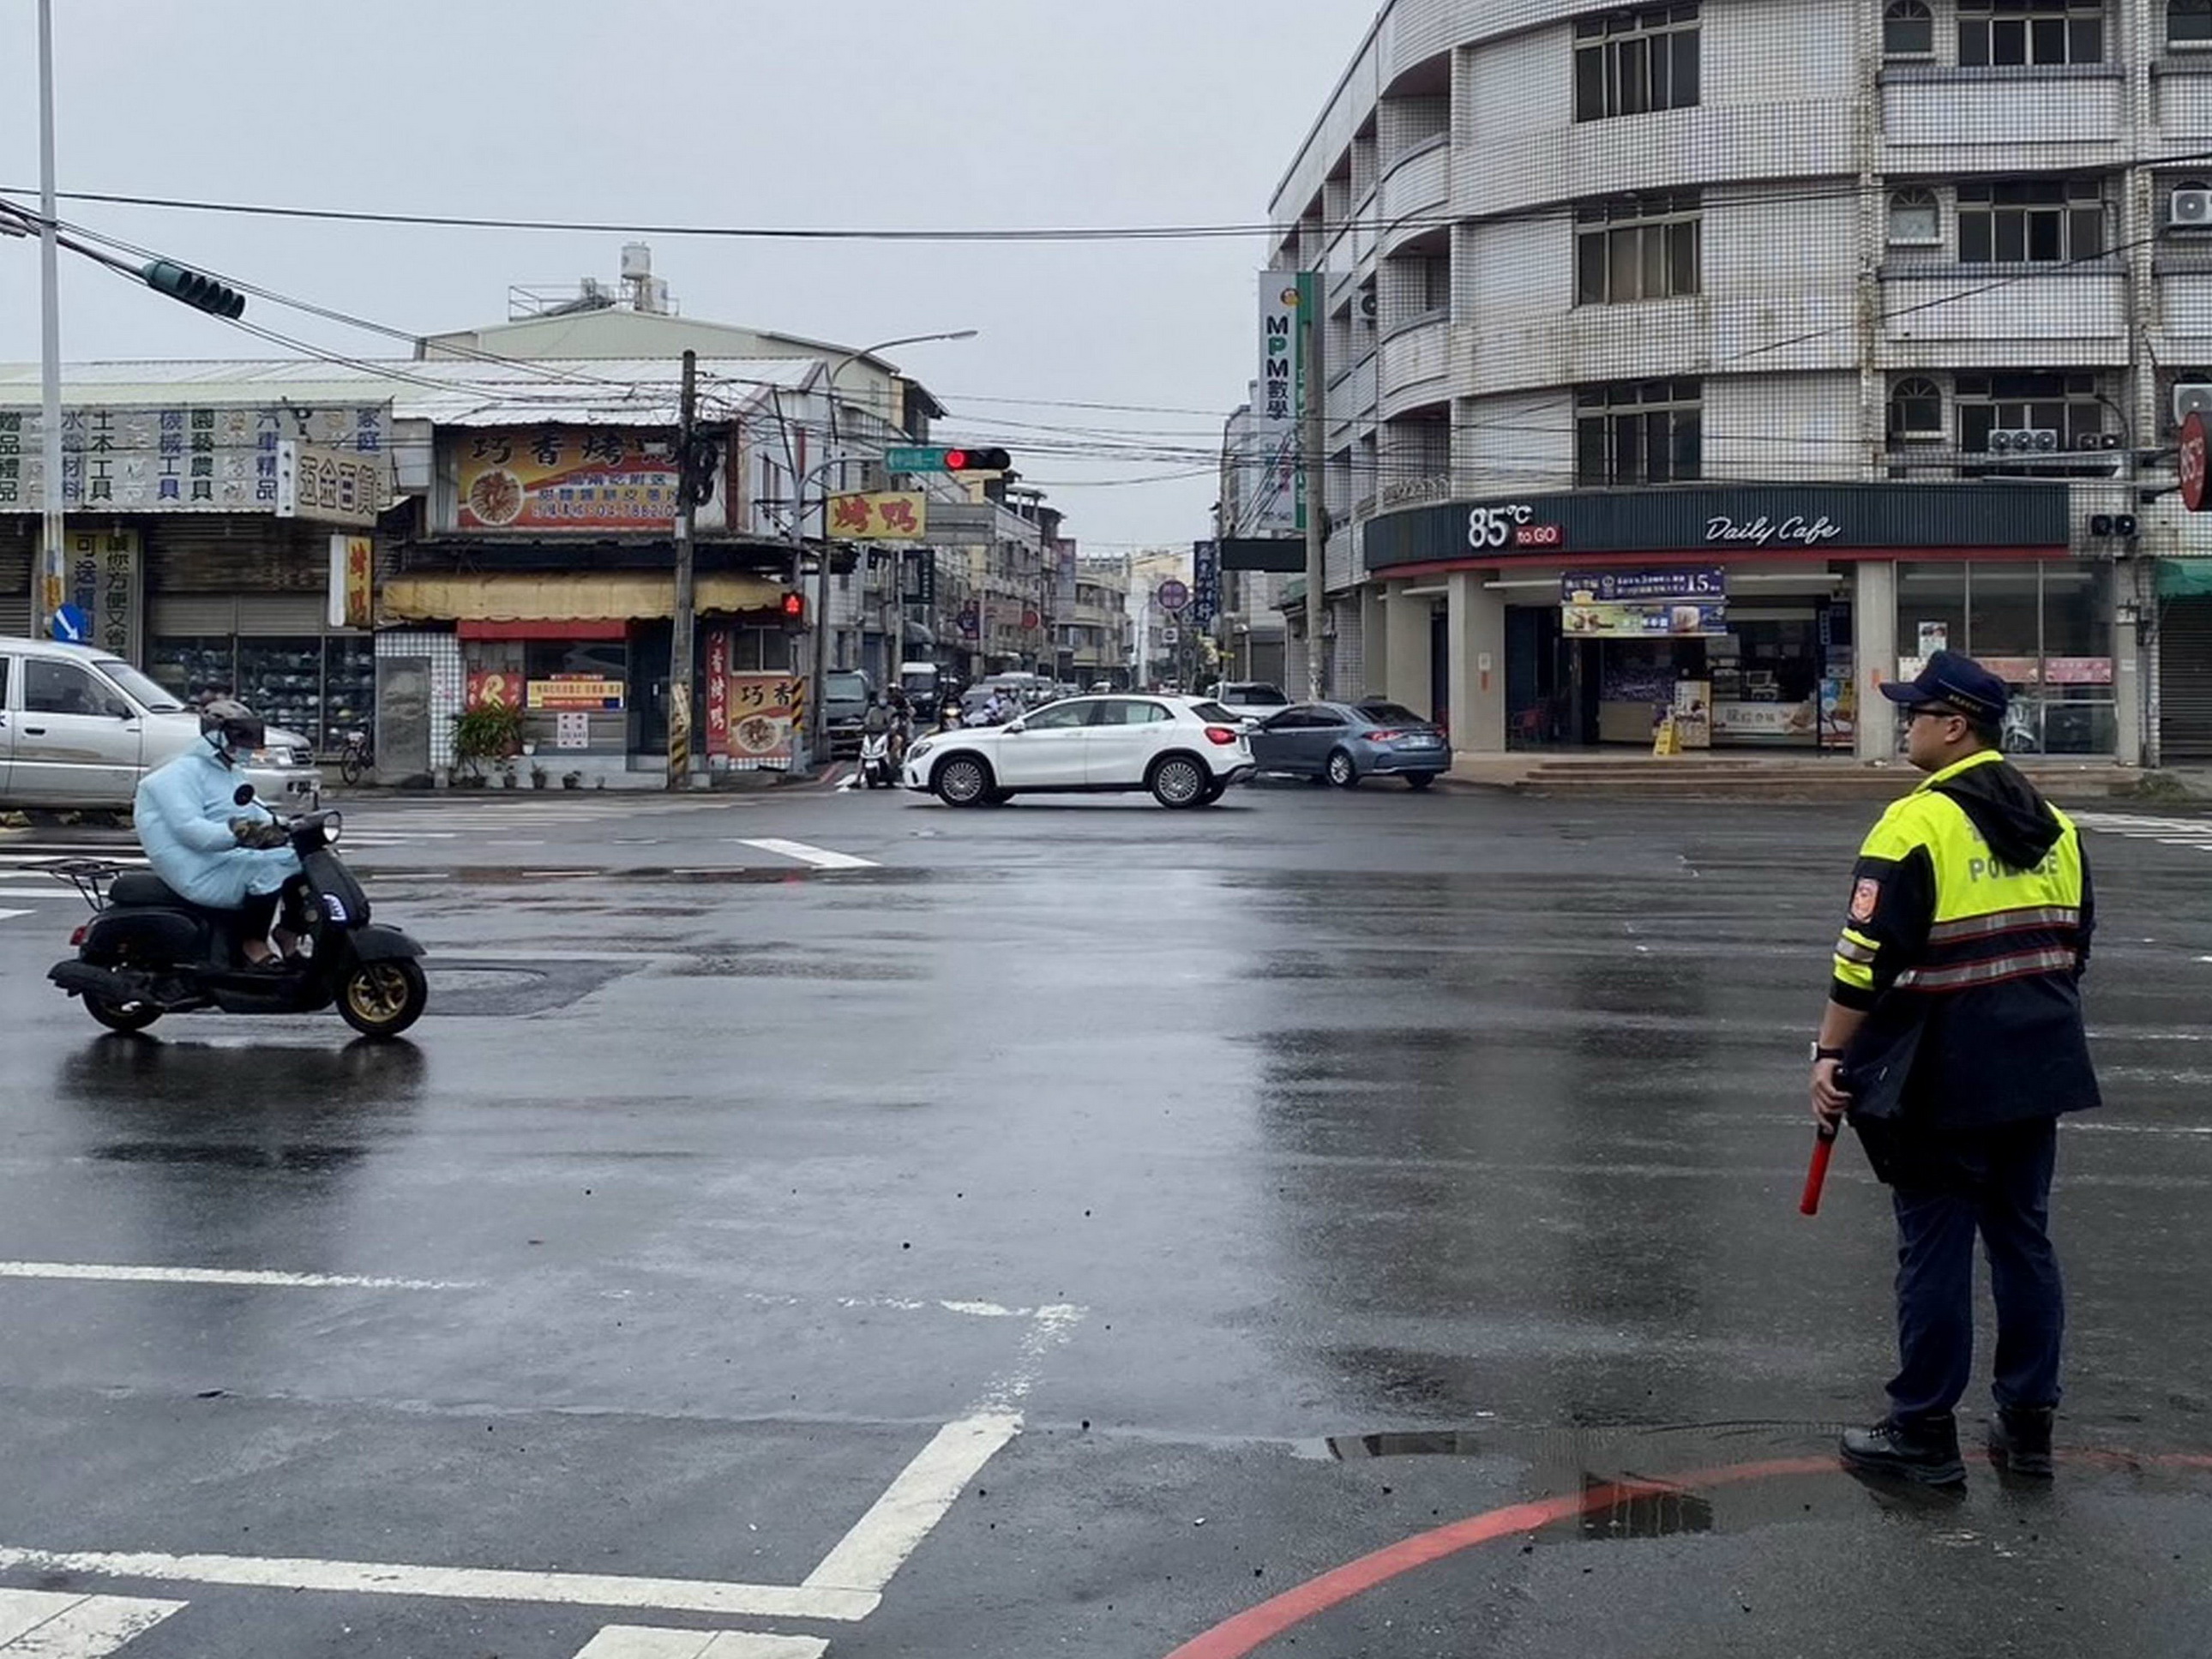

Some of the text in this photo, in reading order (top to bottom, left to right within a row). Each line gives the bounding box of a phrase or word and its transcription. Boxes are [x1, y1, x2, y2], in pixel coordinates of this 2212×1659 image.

[91, 410, 115, 502] 土木工具
[158, 410, 183, 501] 機械工具
[190, 409, 214, 502] 園藝農具
[299, 455, 376, 516] 五金百貨
[833, 495, 917, 533] 烤鴨
[1517, 526, 1557, 543] to GO
[1705, 515, 1842, 546] Daily Cafe
[1968, 850, 2059, 883] POE
